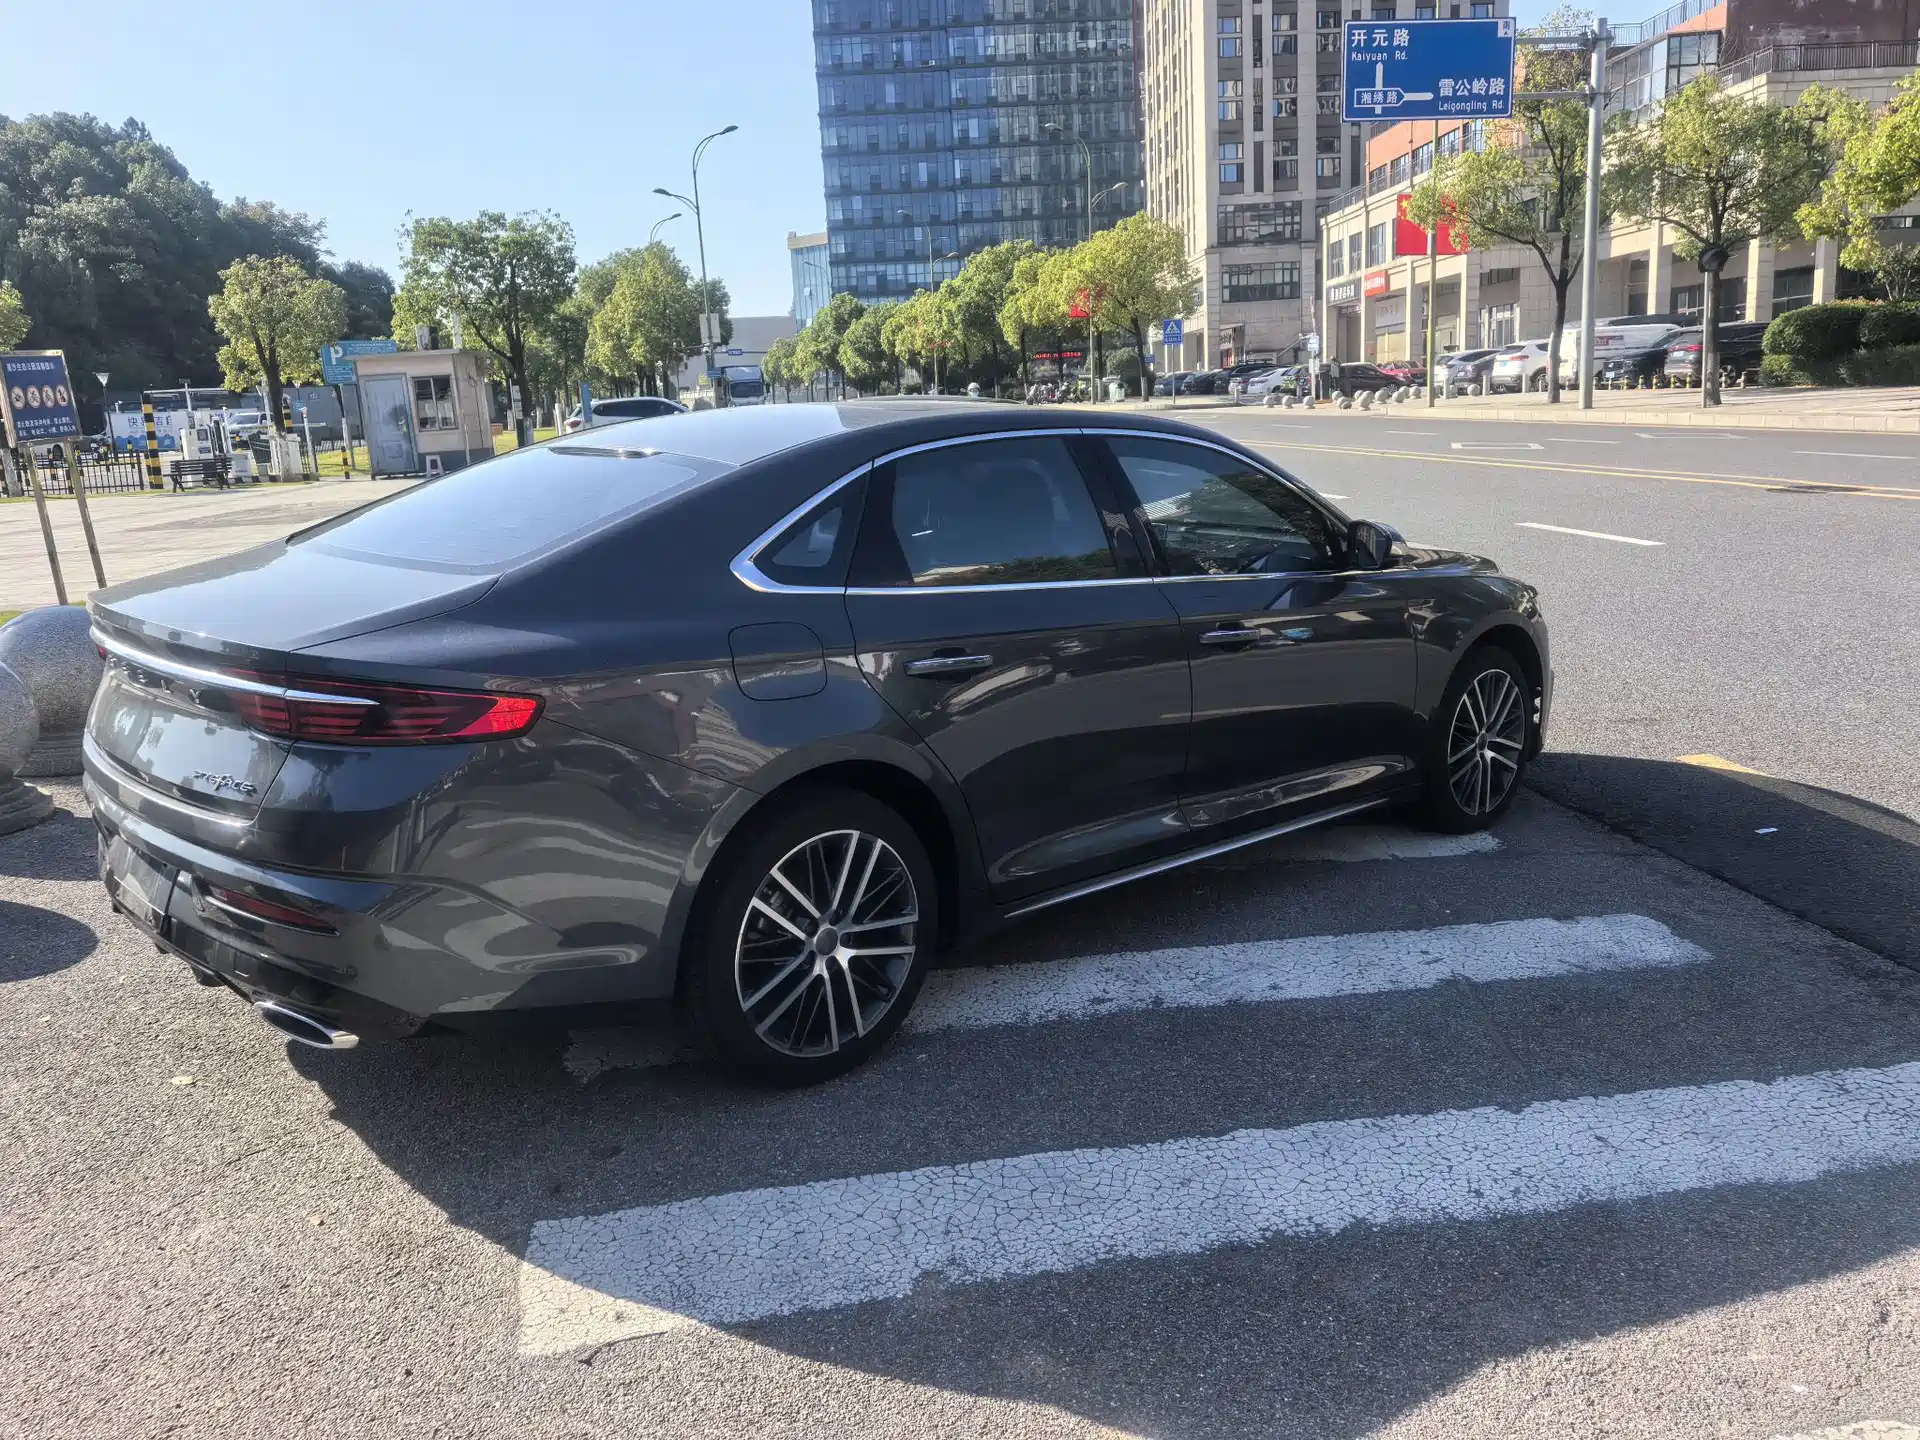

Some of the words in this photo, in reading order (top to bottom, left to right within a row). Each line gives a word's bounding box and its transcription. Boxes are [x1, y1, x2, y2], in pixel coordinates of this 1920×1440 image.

[1351, 28, 1410, 48] 开元路
[1351, 50, 1388, 63] Kaiyuan
[1395, 50, 1408, 60] Rd.
[1438, 77, 1506, 98] 雷公岭路
[1360, 90, 1398, 105] 湘绣路
[1438, 100, 1487, 113] Leigongling
[1492, 99, 1505, 110] Rd.
